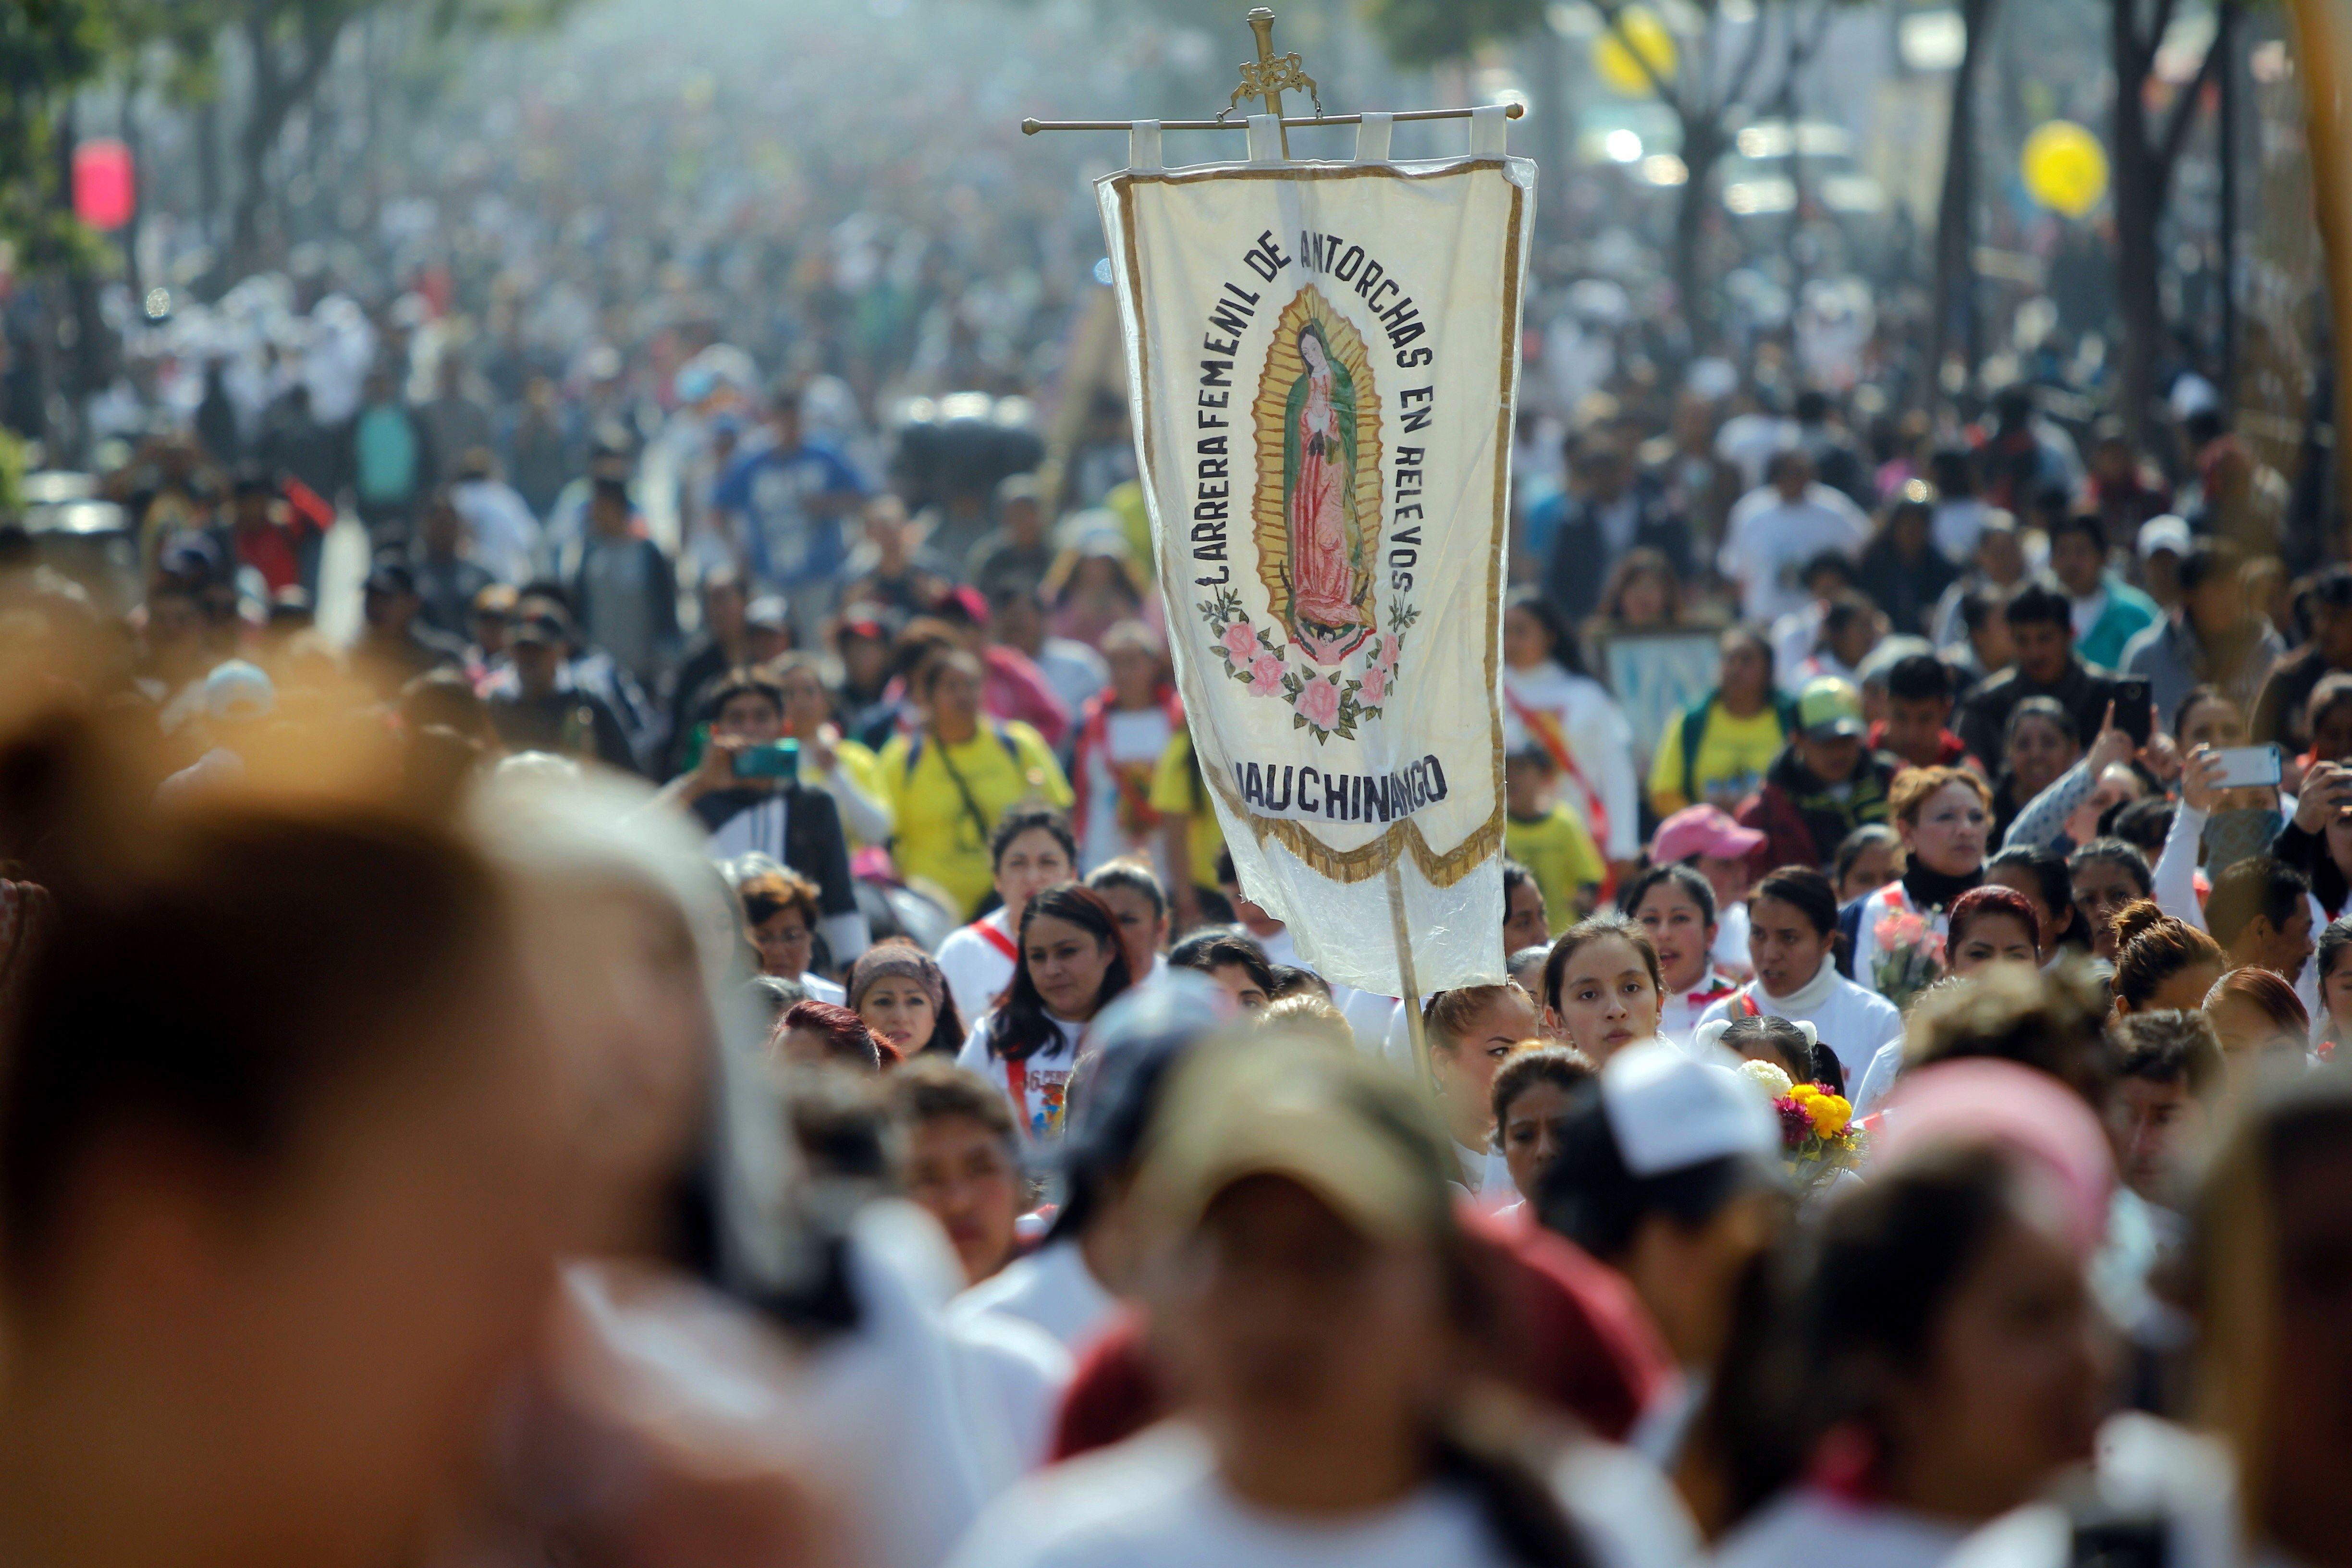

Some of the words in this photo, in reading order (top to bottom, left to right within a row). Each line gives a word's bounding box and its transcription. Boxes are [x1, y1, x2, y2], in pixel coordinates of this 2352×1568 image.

[1243, 230, 1292, 283] DE
[1300, 230, 1433, 368] ANTORCHAS
[1198, 282, 1261, 429] FEMENIL
[1400, 385, 1433, 434] EN
[1389, 446, 1426, 592] RELEVOS
